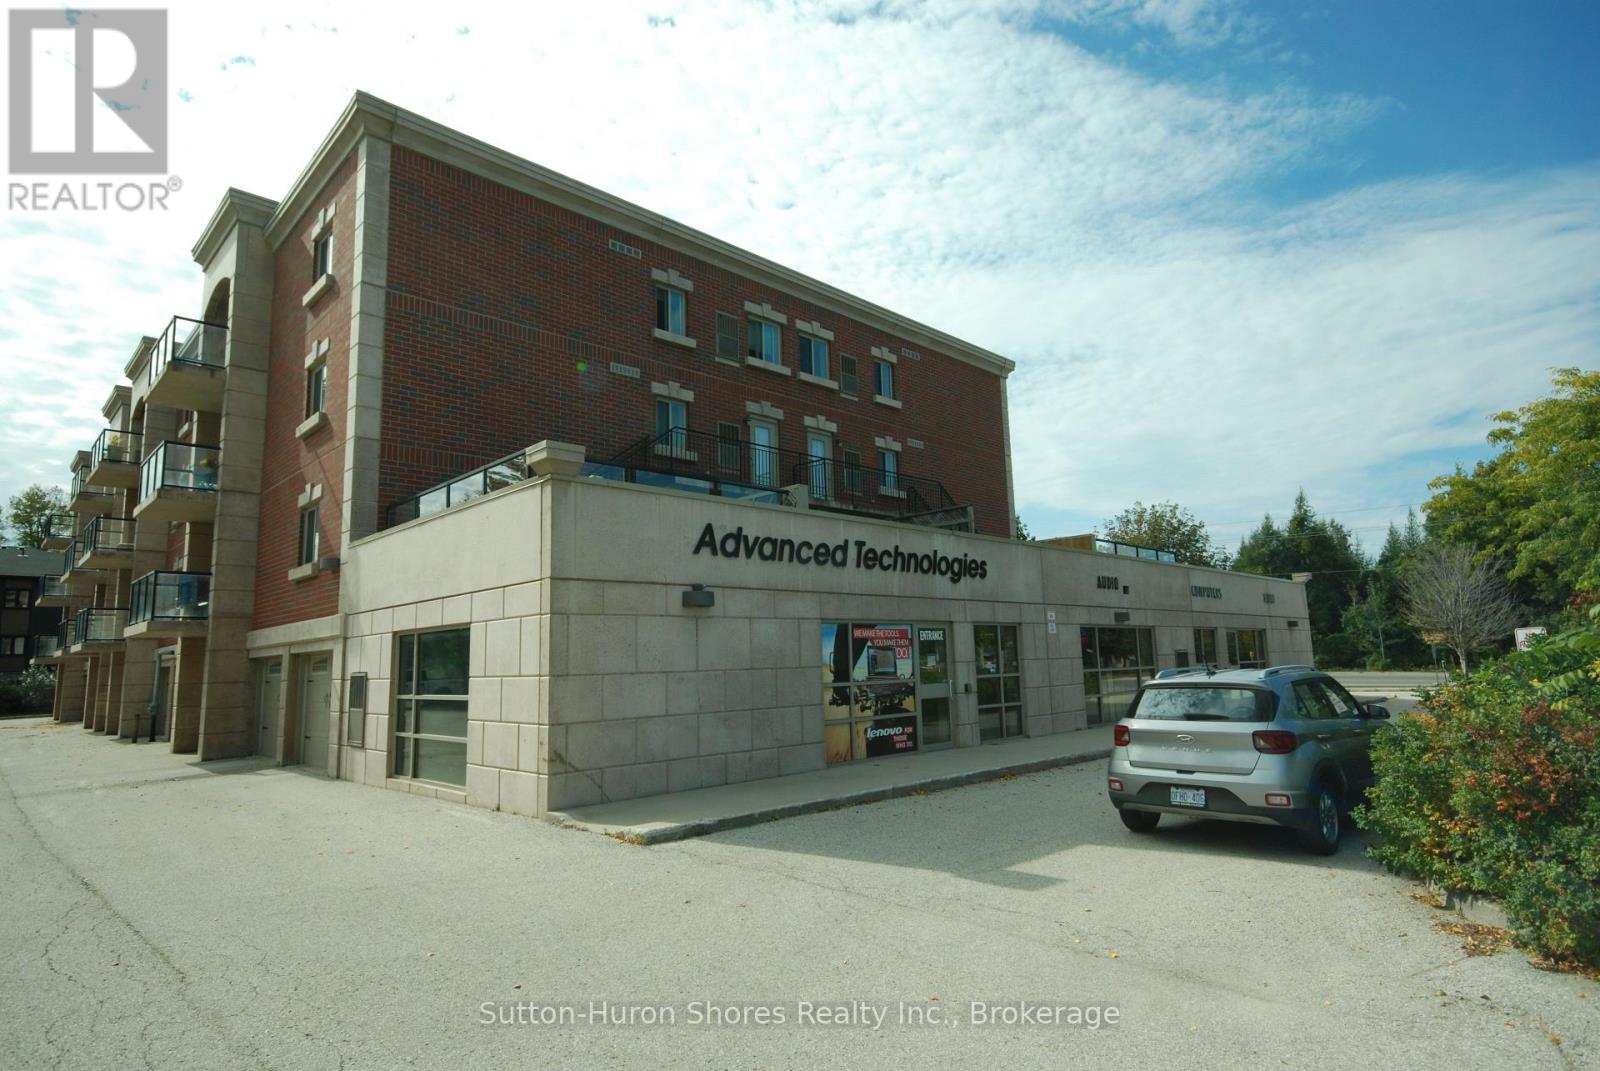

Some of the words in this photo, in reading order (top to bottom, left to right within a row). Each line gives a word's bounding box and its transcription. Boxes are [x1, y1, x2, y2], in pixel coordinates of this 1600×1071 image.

[692, 522, 848, 568] Advanced
[854, 540, 988, 584] Technologies
[1097, 576, 1119, 590] AUDIO
[919, 631, 944, 641] ENTRANCE
[874, 639, 883, 647] YOU
[884, 639, 896, 647] MAKE
[897, 638, 909, 646] THEM
[866, 726, 903, 738] lenovo
